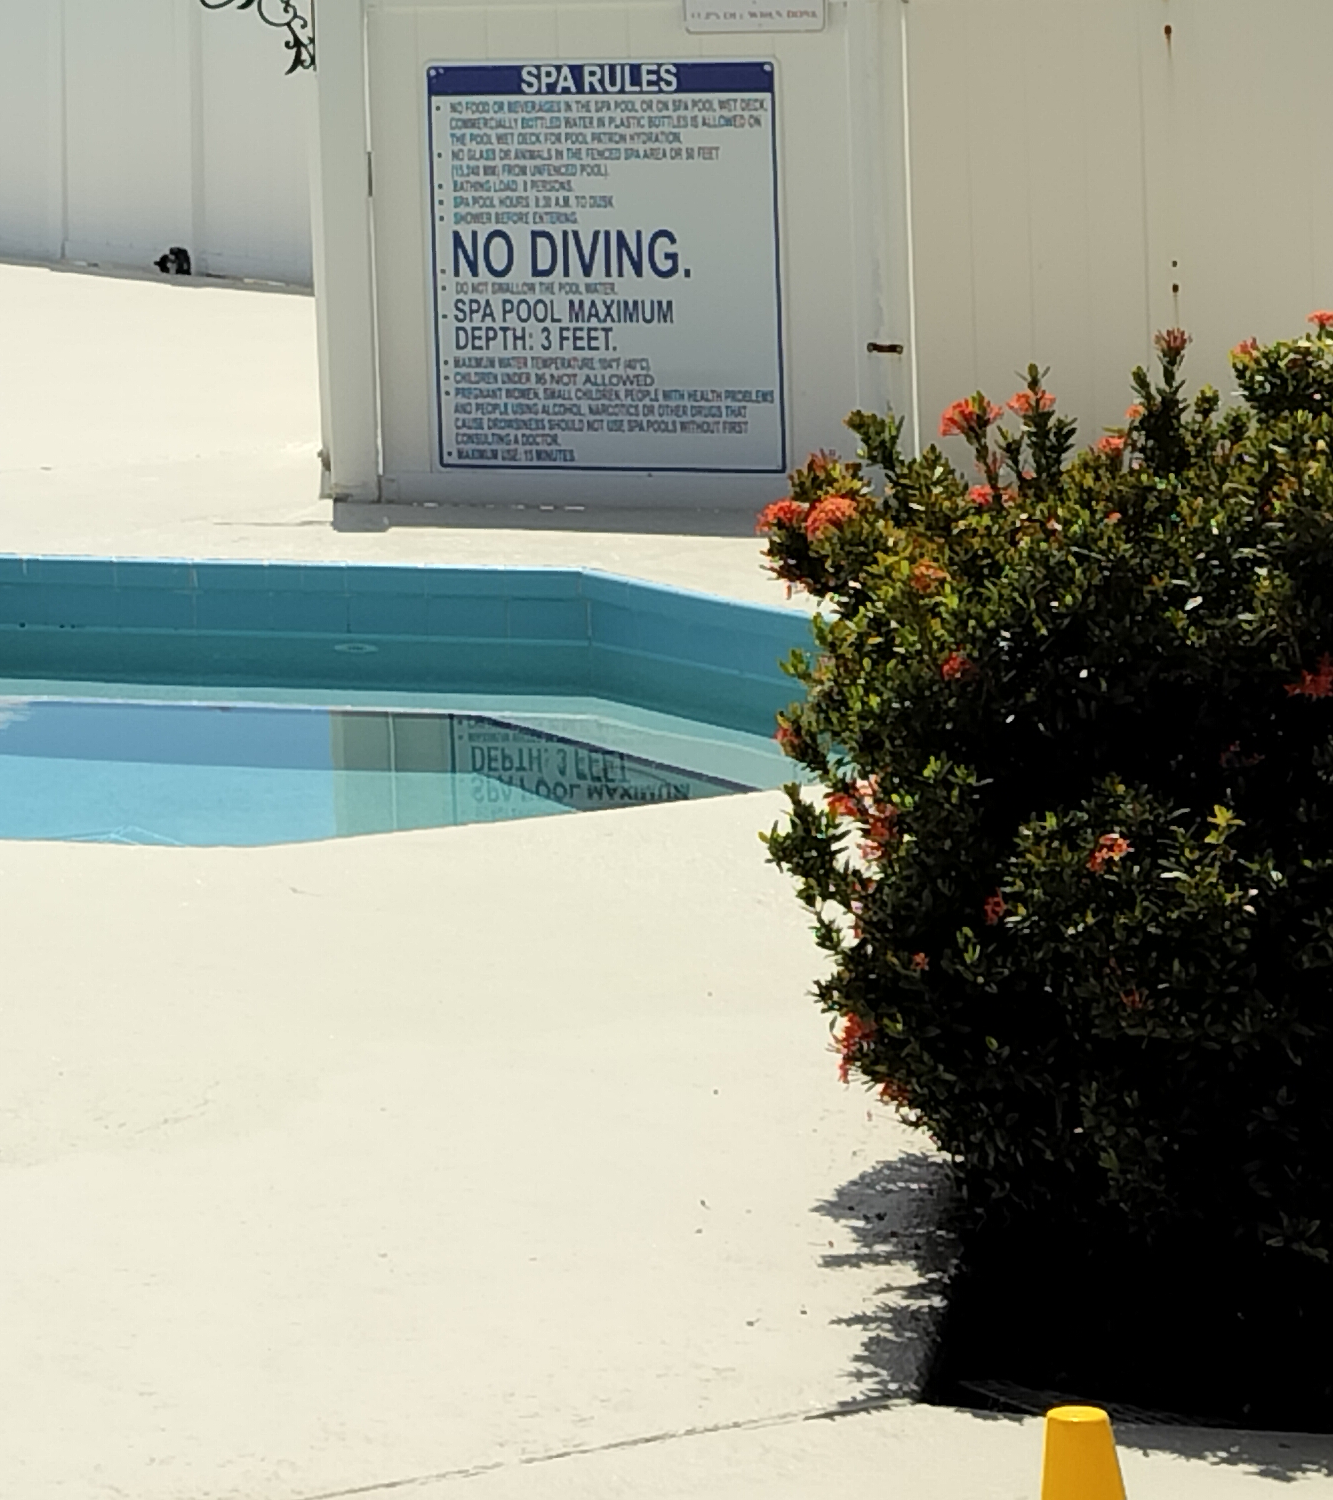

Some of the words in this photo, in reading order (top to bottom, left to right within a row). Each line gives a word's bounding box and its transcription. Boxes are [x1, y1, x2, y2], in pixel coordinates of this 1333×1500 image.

[521, 66, 576, 94] SPA
[583, 64, 678, 93] RULES
[450, 102, 463, 114] NO
[466, 101, 489, 114] FOOD
[492, 101, 504, 114] OR
[575, 100, 591, 113] THE
[595, 101, 611, 113] SPA
[614, 100, 638, 113] POOL
[640, 100, 653, 112] OR
[672, 99, 689, 112] SPA
[692, 99, 716, 112] POOL
[718, 99, 738, 111] WET
[521, 116, 561, 129] BOTTLED
[564, 116, 594, 128] WATER
[609, 116, 645, 128] PLASTIC
[648, 115, 688, 128] BOTTLES
[702, 115, 745, 128] ALLOWED
[450, 133, 466, 146] THE
[470, 133, 492, 145] POOL
[495, 133, 514, 145] WET
[517, 132, 542, 145] DECK
[545, 132, 562, 144] FOR
[565, 132, 588, 144] POOL
[452, 149, 464, 161] NO
[467, 149, 495, 161] GLASS
[499, 148, 511, 161] OR
[514, 149, 552, 160] ANIMALS
[567, 148, 582, 160] THE
[586, 148, 621, 160] FENCED
[624, 148, 640, 160] SPA
[643, 148, 667, 160] AREA
[698, 147, 720, 160] FEET
[502, 164, 527, 177] FROM
[529, 164, 577, 177] UNFENCED
[453, 180, 492, 192] BATHING
[453, 196, 472, 208] SPA
[472, 196, 496, 208] POOL
[575, 195, 587, 208] TO
[453, 212, 492, 225] SHOWER
[495, 212, 530, 224] BEFORE
[453, 229, 514, 279] NO
[531, 228, 692, 279] DIVING.
[456, 282, 468, 295] DO
[471, 282, 488, 294] NOT
[492, 282, 536, 295] SWALLOW
[539, 282, 555, 295] THE
[559, 282, 582, 295] POOL
[454, 299, 496, 324] SPA
[502, 299, 561, 324] POOL
[569, 299, 674, 324] MAXIMUM
[455, 328, 533, 352] DEPTH:
[541, 328, 551, 352] 3
[558, 328, 618, 352] FEET.
[454, 357, 495, 369] MAXIMUM
[498, 357, 527, 369] WATER
[454, 372, 498, 385] CHILDREN
[501, 372, 531, 385] UNDER
[550, 374, 578, 385] NOT
[583, 374, 654, 385] ALLOWED
[455, 387, 502, 399] PREGNANT
[544, 388, 573, 400] SMALL
[625, 388, 659, 402] PEOPLE
[663, 390, 685, 401] WITH
[688, 390, 722, 402] HEALTH
[725, 390, 774, 403] PROBLEMS
[454, 402, 472, 414] AND
[475, 402, 509, 415] PEOPLE
[512, 403, 539, 415] USING
[588, 404, 640, 416] NARCOTICS
[643, 404, 655, 417] OR
[658, 404, 688, 417] OTHER
[690, 405, 722, 418] DRUGS
[725, 406, 747, 418] THAT
[455, 418, 484, 430] CAUSE
[488, 418, 546, 431] DROWSINESS
[548, 419, 584, 432] SHOULD
[587, 419, 605, 432] NOT
[627, 420, 645, 432] SPA
[647, 420, 677, 433] POOLS
[680, 421, 721, 433] WITHOUT
[722, 421, 748, 434] FIRST
[456, 433, 512, 445] CONSULTING
[514, 434, 520, 445] A
[457, 449, 498, 460] MAXIMUM
